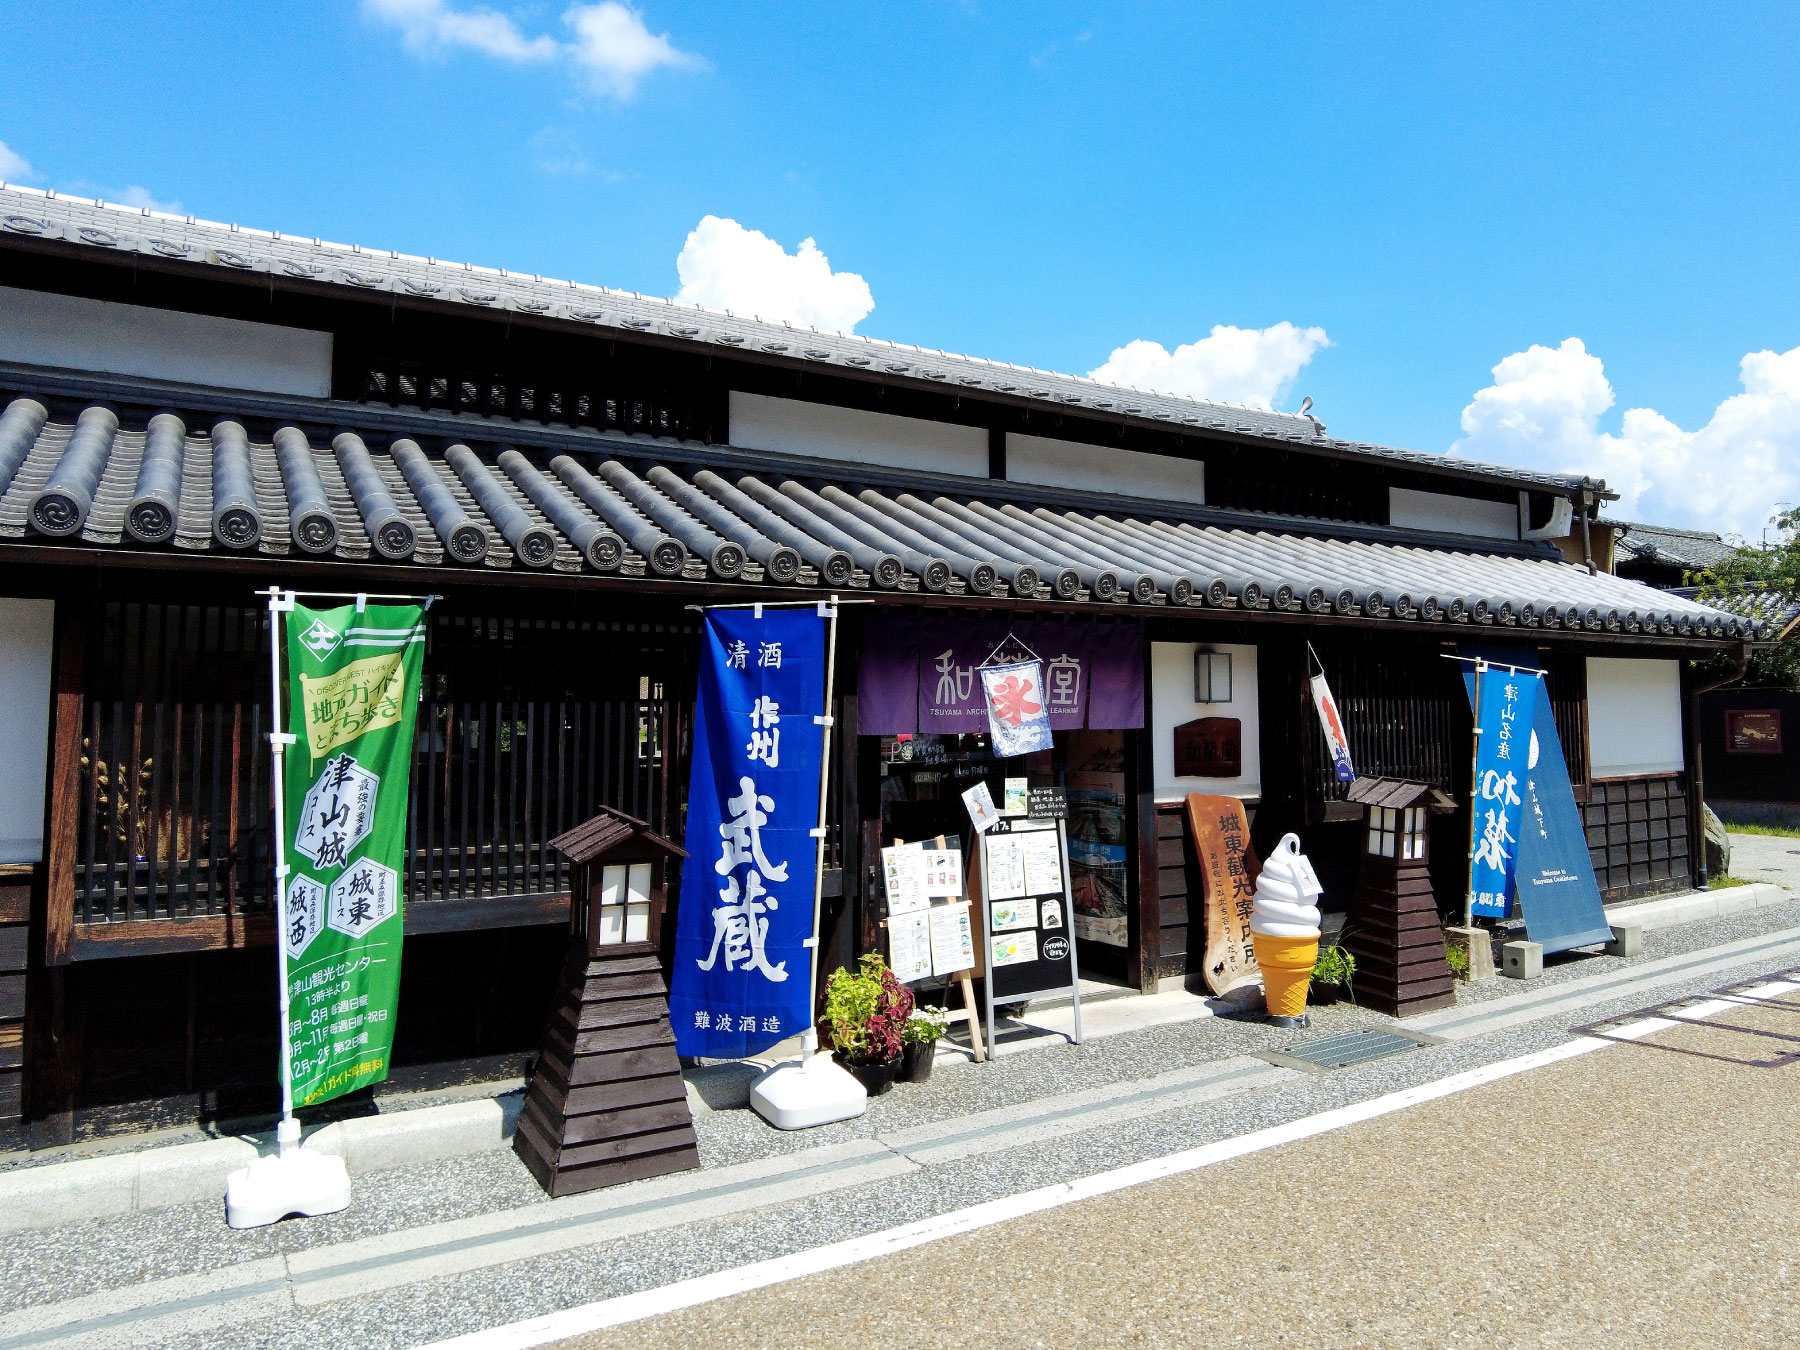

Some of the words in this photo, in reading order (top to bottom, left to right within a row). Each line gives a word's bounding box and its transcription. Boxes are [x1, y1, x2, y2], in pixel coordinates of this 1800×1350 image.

[726, 639, 783, 669] 清酒
[316, 677, 347, 695] DISCOVER
[934, 649, 1081, 705] 和堂
[311, 668, 398, 724] 地元ガイド
[930, 708, 962, 716] TSUYAMA
[966, 708, 988, 716] ARCHI
[1050, 706, 1079, 715] LEARNING
[990, 675, 1042, 726] 氷
[316, 696, 399, 750] とまち歩き
[304, 796, 319, 838] コース
[315, 754, 355, 868] 津山城
[1528, 779, 1547, 840] 津山城下町
[1532, 878, 1553, 886] Tsuyama
[1541, 869, 1561, 877] Welcome
[337, 886, 346, 919] コース
[346, 869, 375, 926] 城東
[289, 885, 308, 947] 城西
[305, 980, 351, 1007] 13時半より
[330, 994, 369, 1016] 毎週日曜
[693, 1010, 781, 1034] 難波酒造
[333, 1031, 369, 1055] 第2日曜
